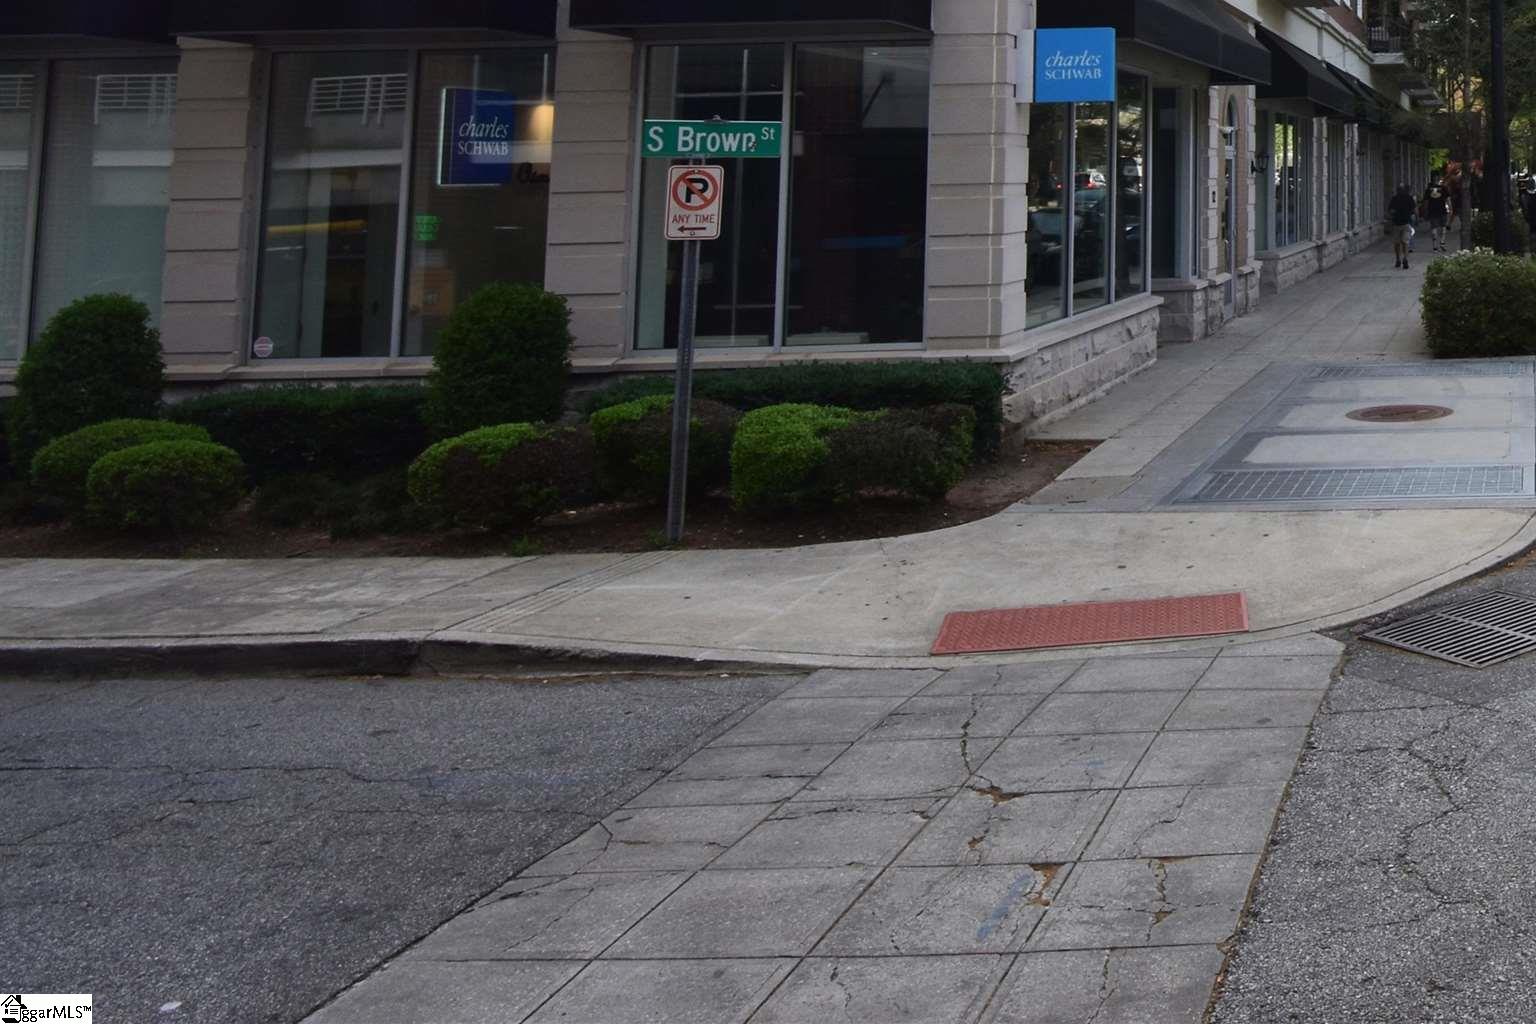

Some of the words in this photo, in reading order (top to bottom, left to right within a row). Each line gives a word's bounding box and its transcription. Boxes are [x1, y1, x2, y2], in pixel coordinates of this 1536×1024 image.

[1045, 50, 1102, 68] charles
[1044, 67, 1102, 80] SCHWAB
[458, 115, 510, 138] charles
[647, 126, 664, 152] S
[677, 126, 756, 152] Brown
[760, 126, 776, 141] St
[457, 140, 509, 156] SCHWAB
[671, 214, 690, 224] ANY
[694, 214, 716, 224] TIME
